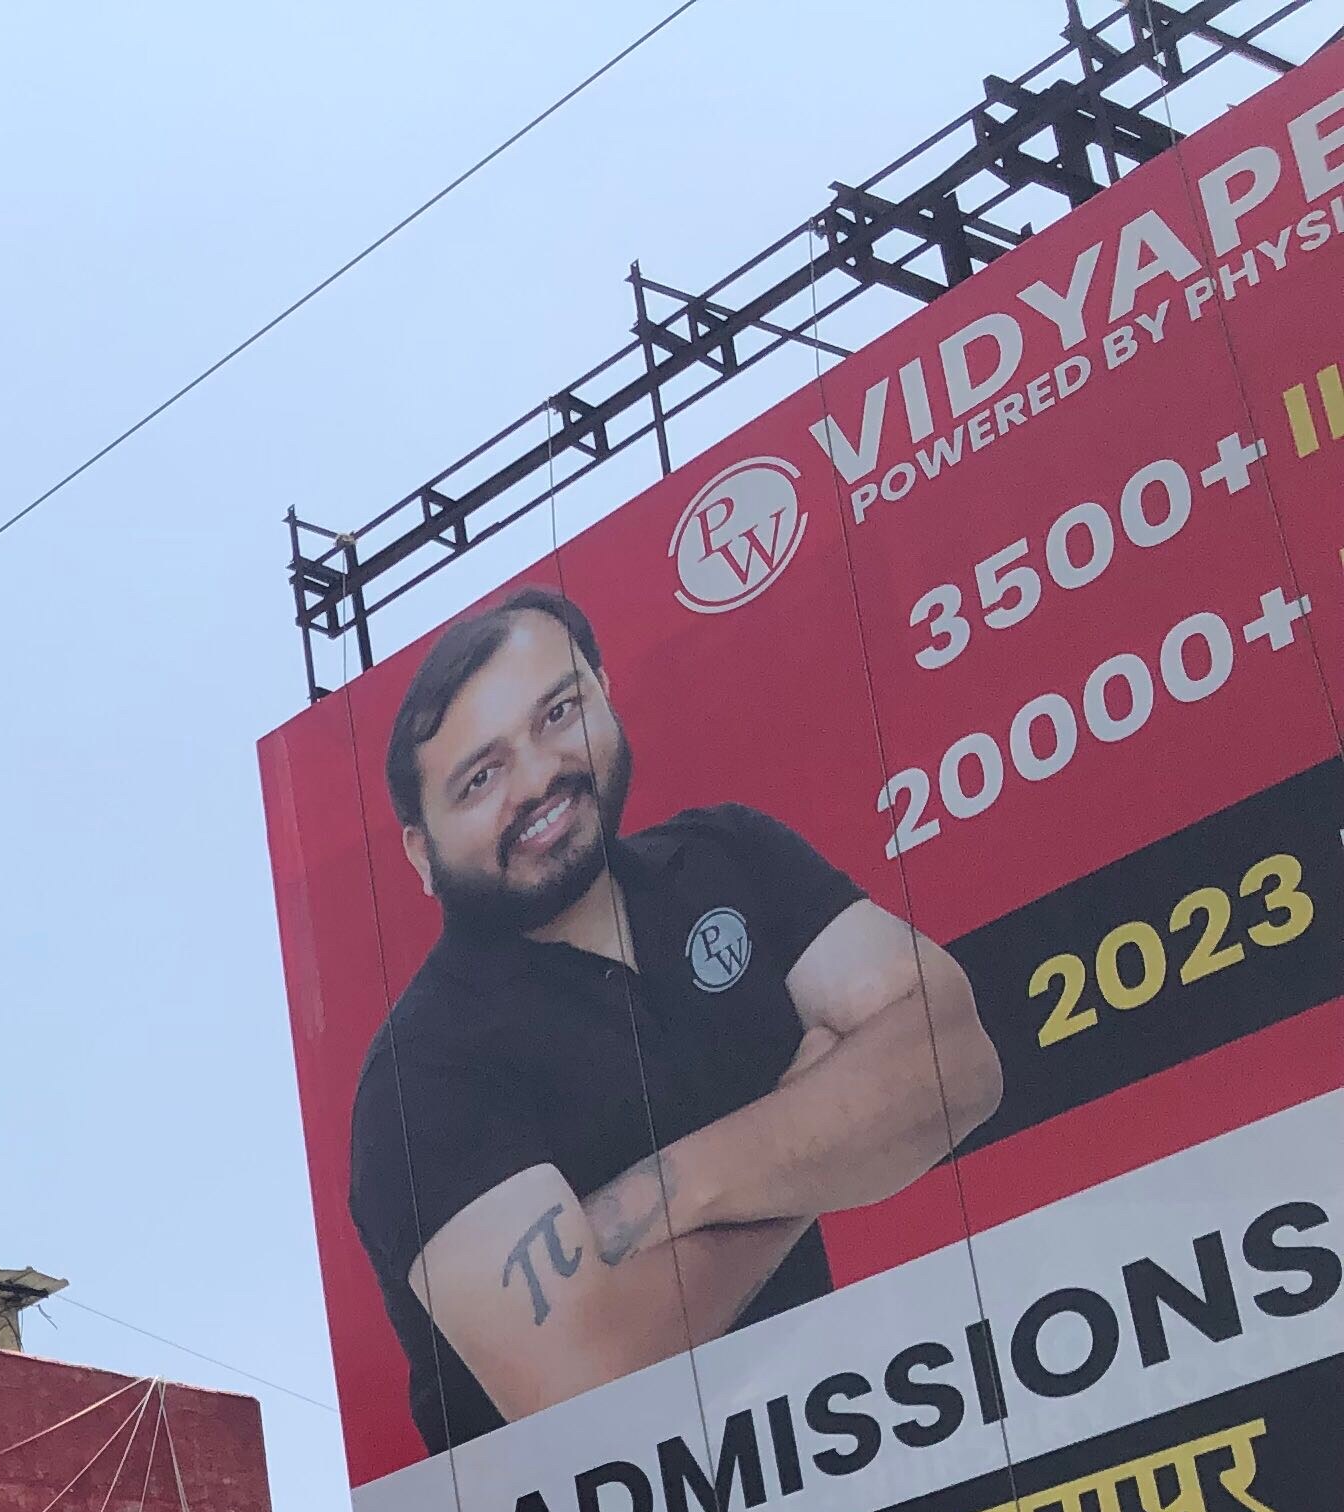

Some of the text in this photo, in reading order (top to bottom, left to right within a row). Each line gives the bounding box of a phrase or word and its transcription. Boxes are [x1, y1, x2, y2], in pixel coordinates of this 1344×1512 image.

[849, 355, 1091, 525] POWERED
[1106, 302, 1168, 371] BY
[909, 431, 1267, 670] 3500+
[875, 585, 1312, 861] 20000+
[1027, 852, 1315, 1049] 2023
